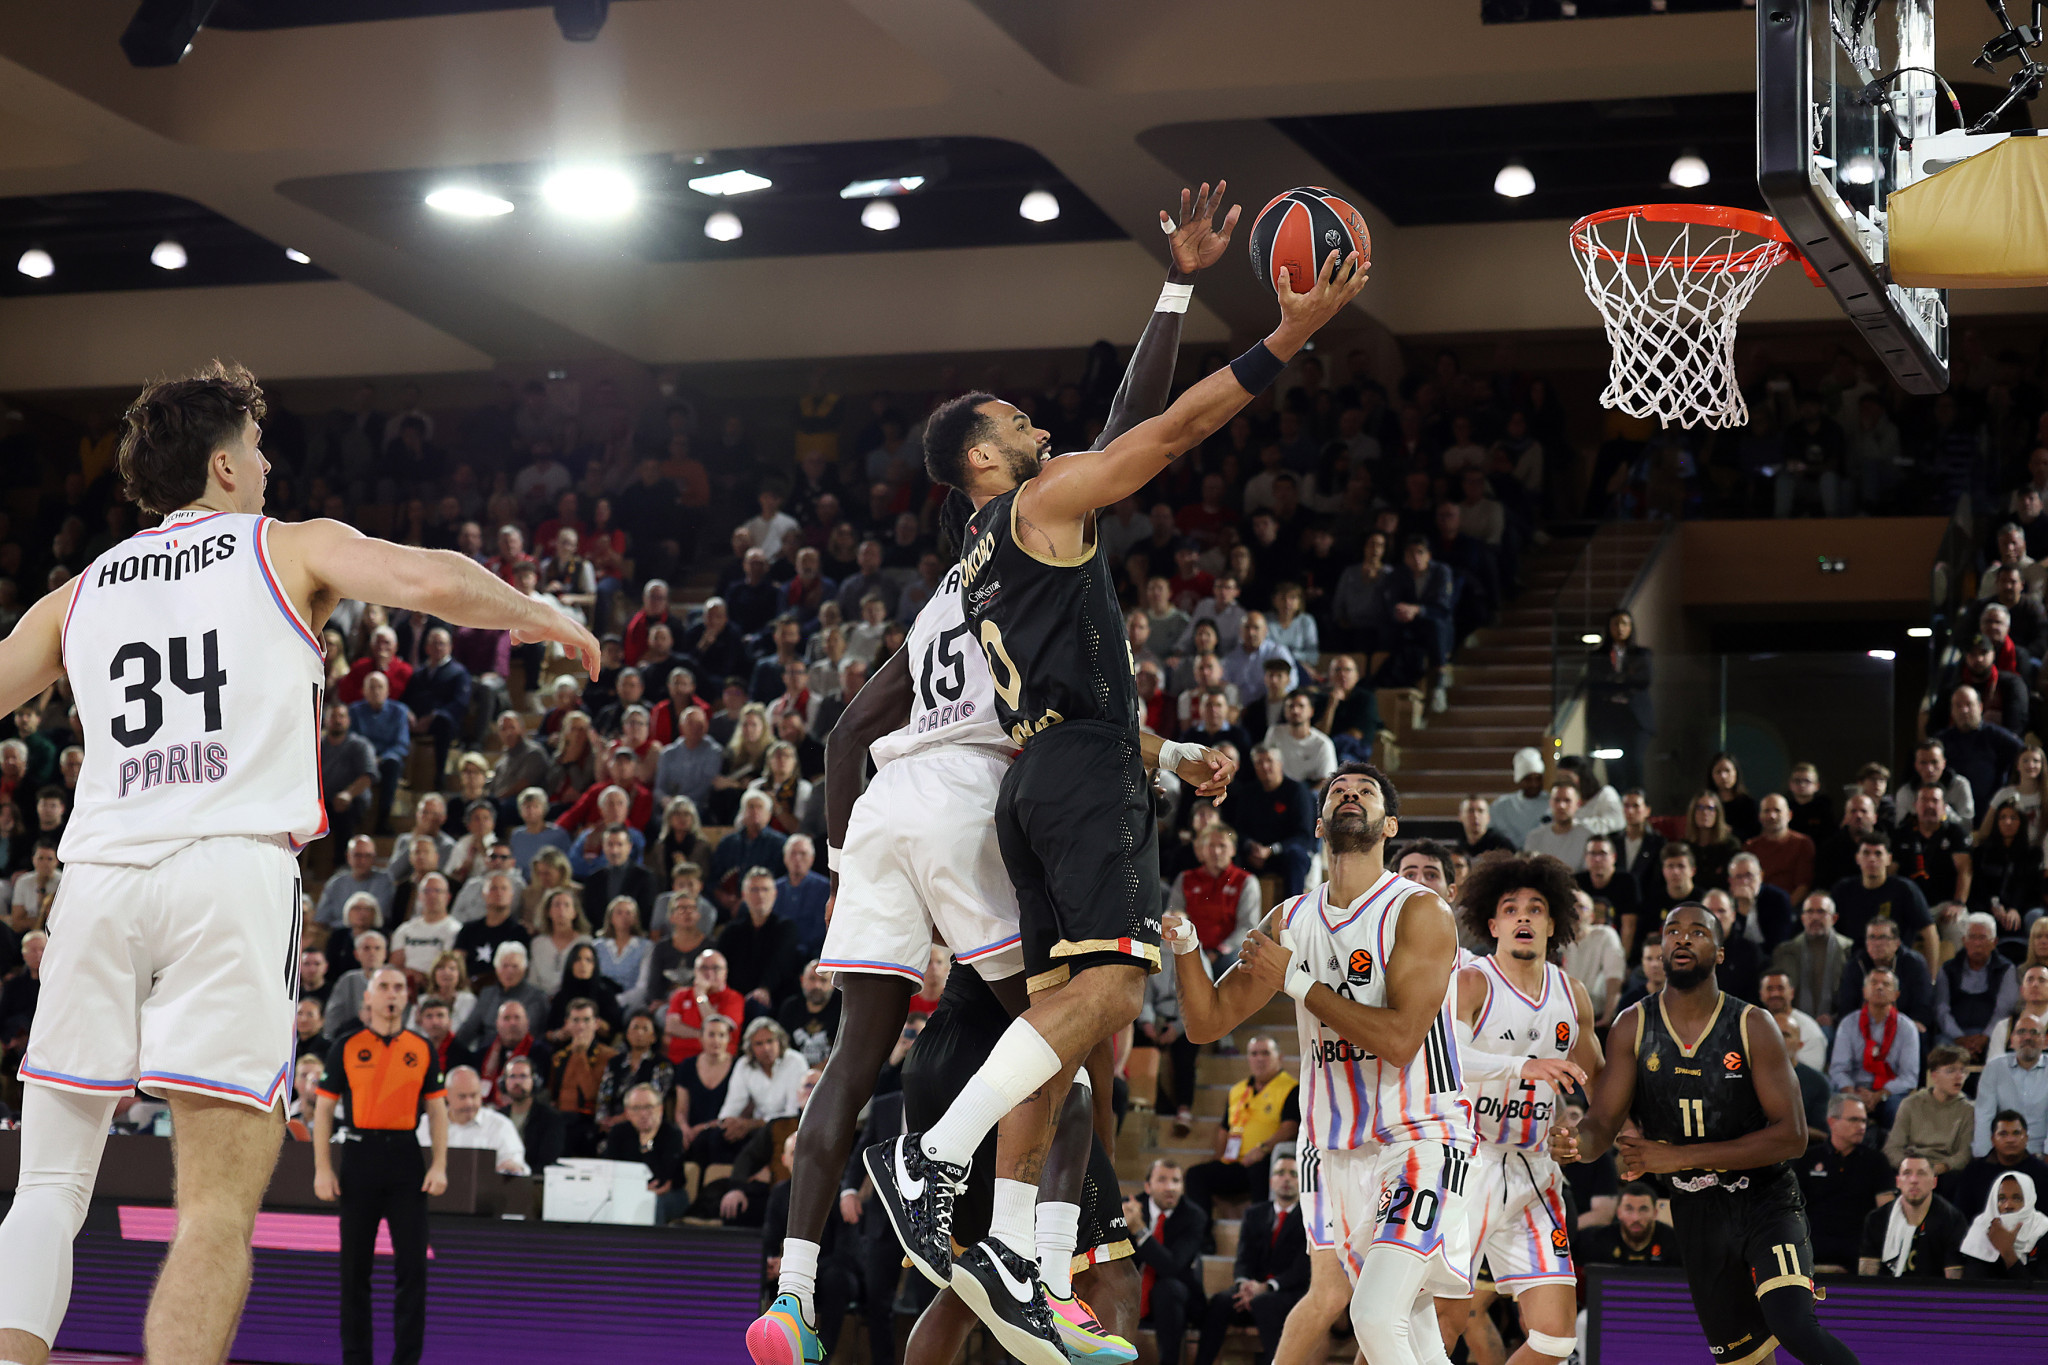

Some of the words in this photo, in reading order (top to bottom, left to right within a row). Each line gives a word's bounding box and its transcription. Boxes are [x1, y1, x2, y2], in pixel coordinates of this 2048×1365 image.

[165, 511, 197, 526] TECHFIT
[98, 533, 237, 588] HOMMES
[960, 531, 996, 588] OKOBO
[109, 628, 228, 749] 34
[920, 622, 969, 711] 15
[980, 619, 1022, 712] 0
[918, 700, 977, 734] PARIS
[117, 740, 229, 799] PARIS
[1678, 1098, 1706, 1138] 11
[1385, 1186, 1440, 1232] 20
[1771, 1243, 1802, 1276] 11
